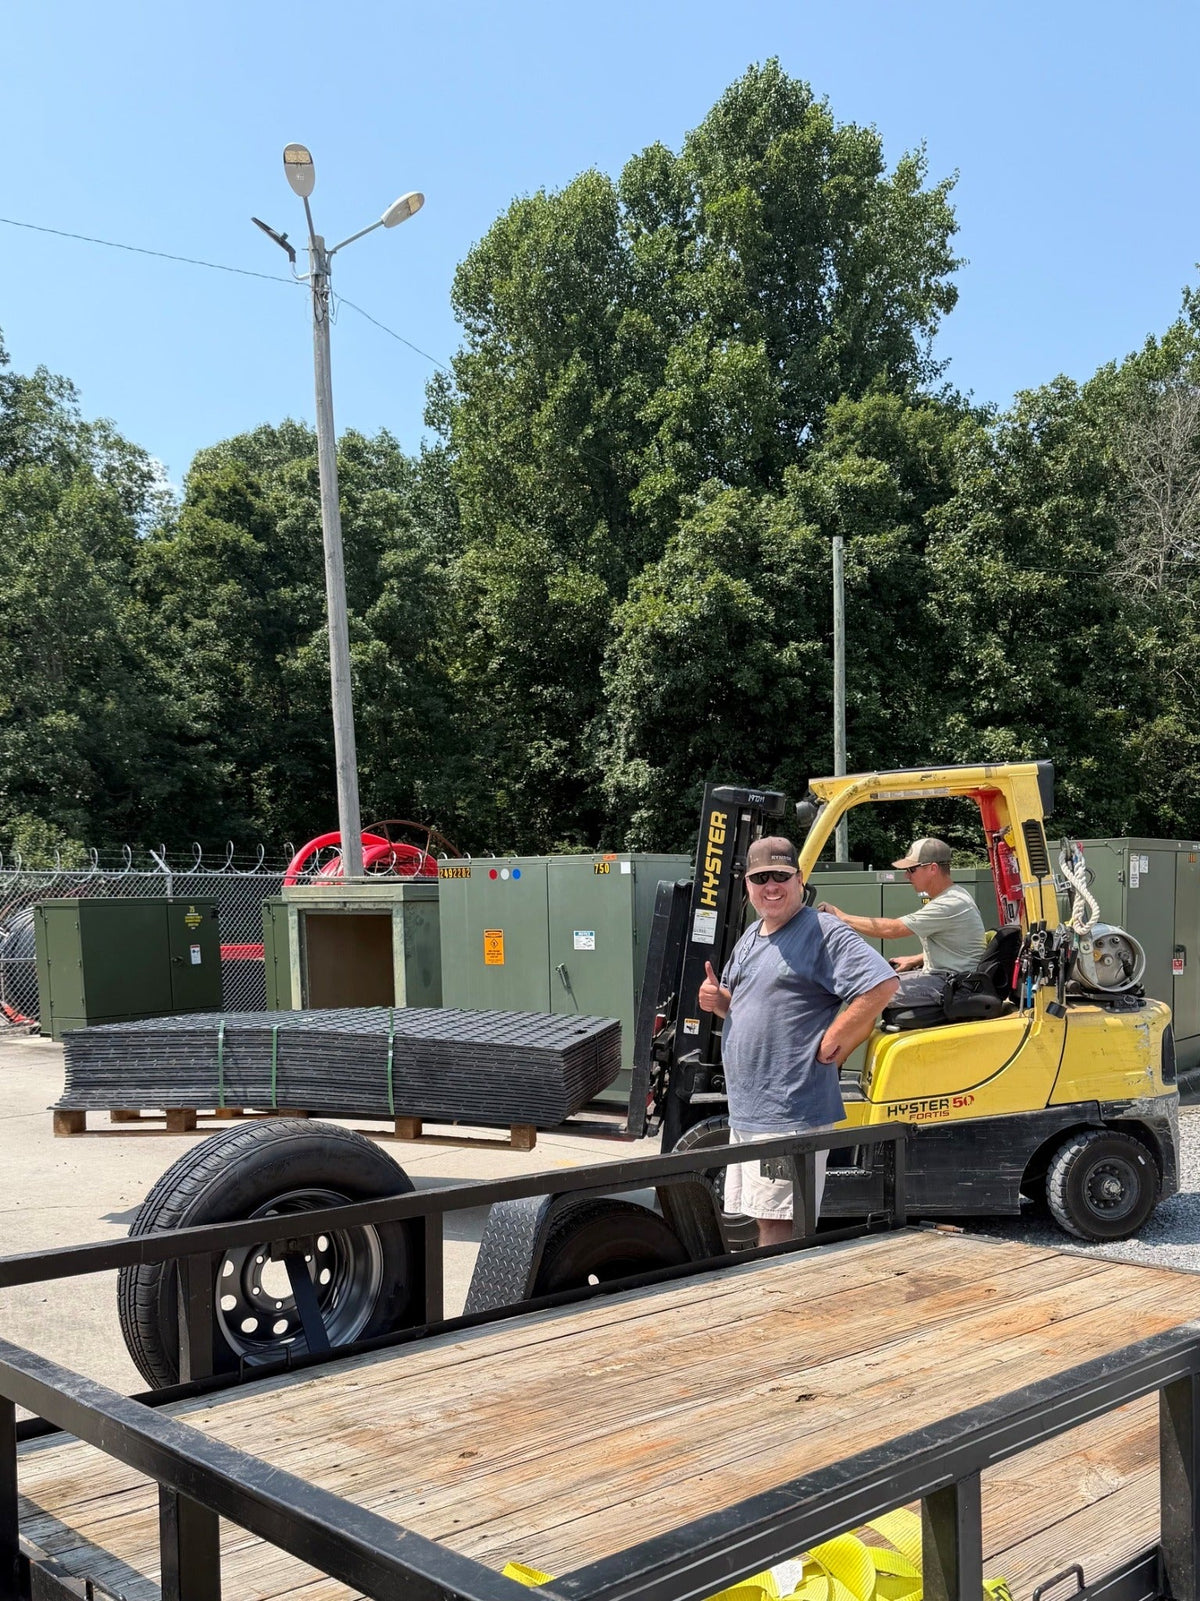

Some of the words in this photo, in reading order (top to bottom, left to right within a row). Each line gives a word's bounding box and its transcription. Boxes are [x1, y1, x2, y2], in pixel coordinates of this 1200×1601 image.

[701, 810, 728, 907] HYSTER
[594, 863, 610, 874] 750
[887, 1098, 949, 1118] HYSTER
[952, 1095, 975, 1108] 50
[909, 1110, 950, 1121] FORTIS
